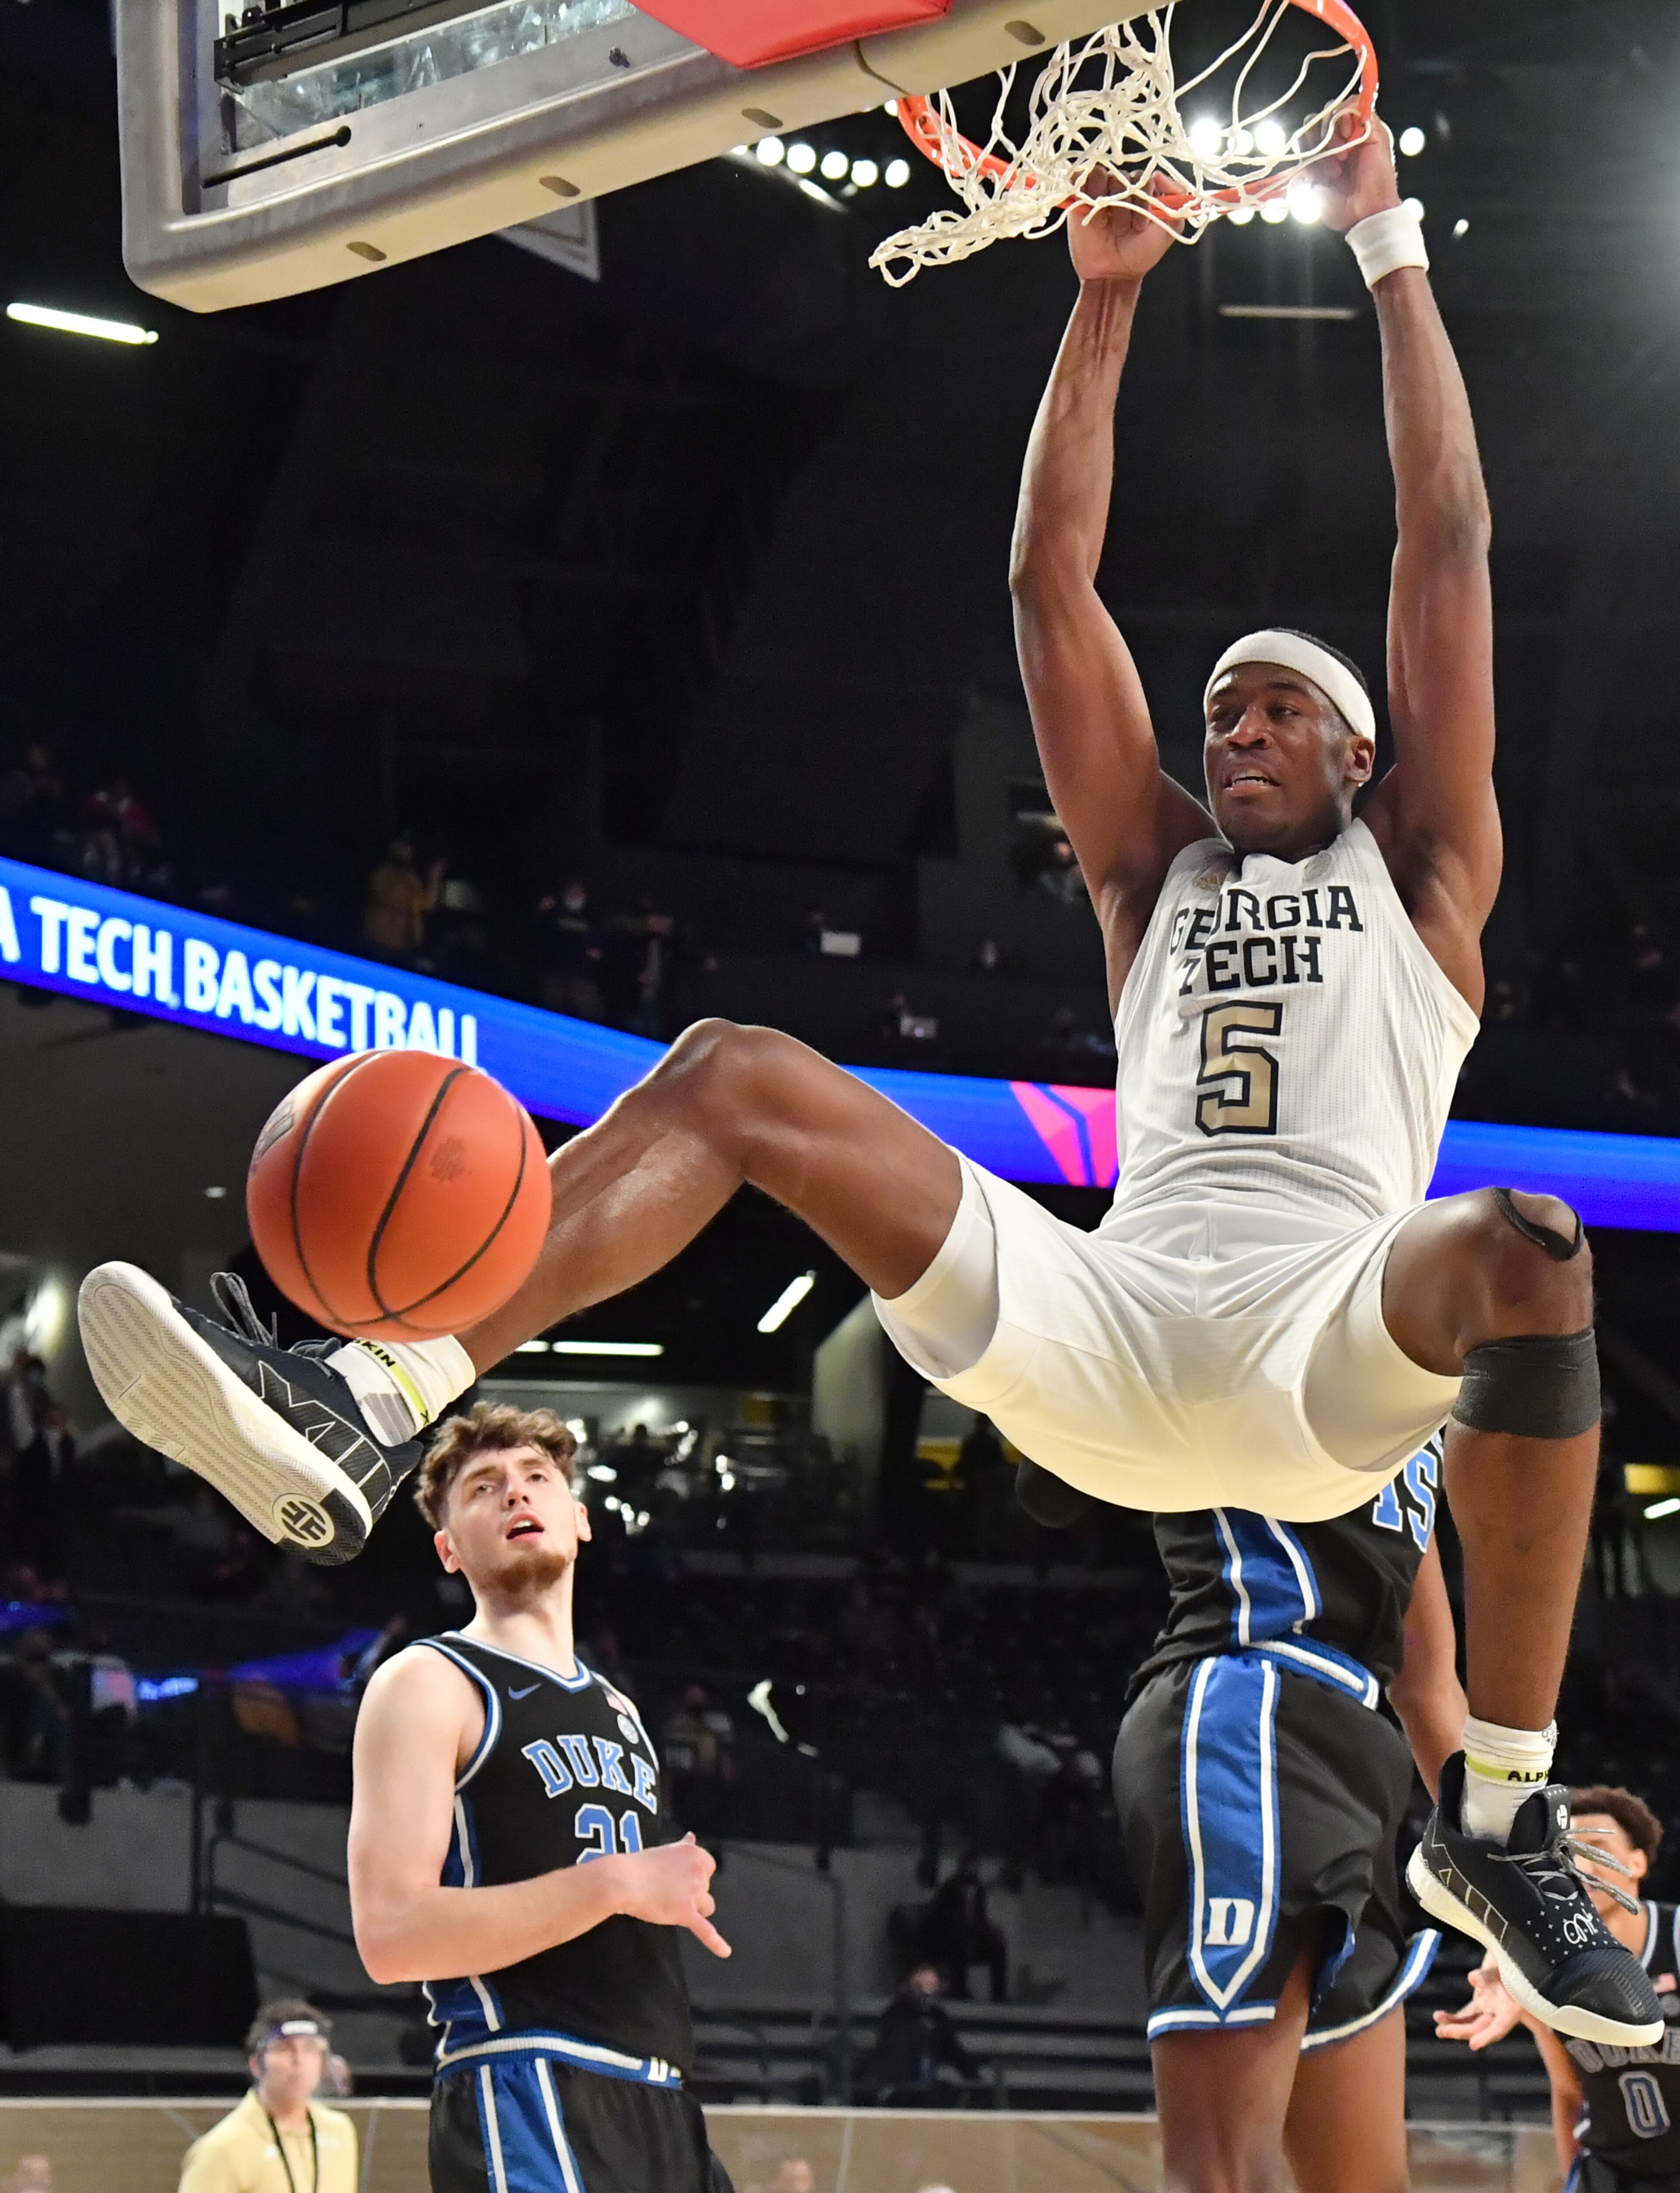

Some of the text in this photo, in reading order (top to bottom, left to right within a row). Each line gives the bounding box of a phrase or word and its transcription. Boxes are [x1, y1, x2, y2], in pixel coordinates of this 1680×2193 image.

[30, 895, 172, 1003] TECH
[184, 939, 487, 1074] BASKETBALL
[1195, 1000, 1283, 1137] 5
[521, 1734, 657, 1815] DUKE
[574, 1803, 643, 1865] 21
[1204, 1897, 1255, 1945] D
[1618, 2071, 1671, 2138] 0
